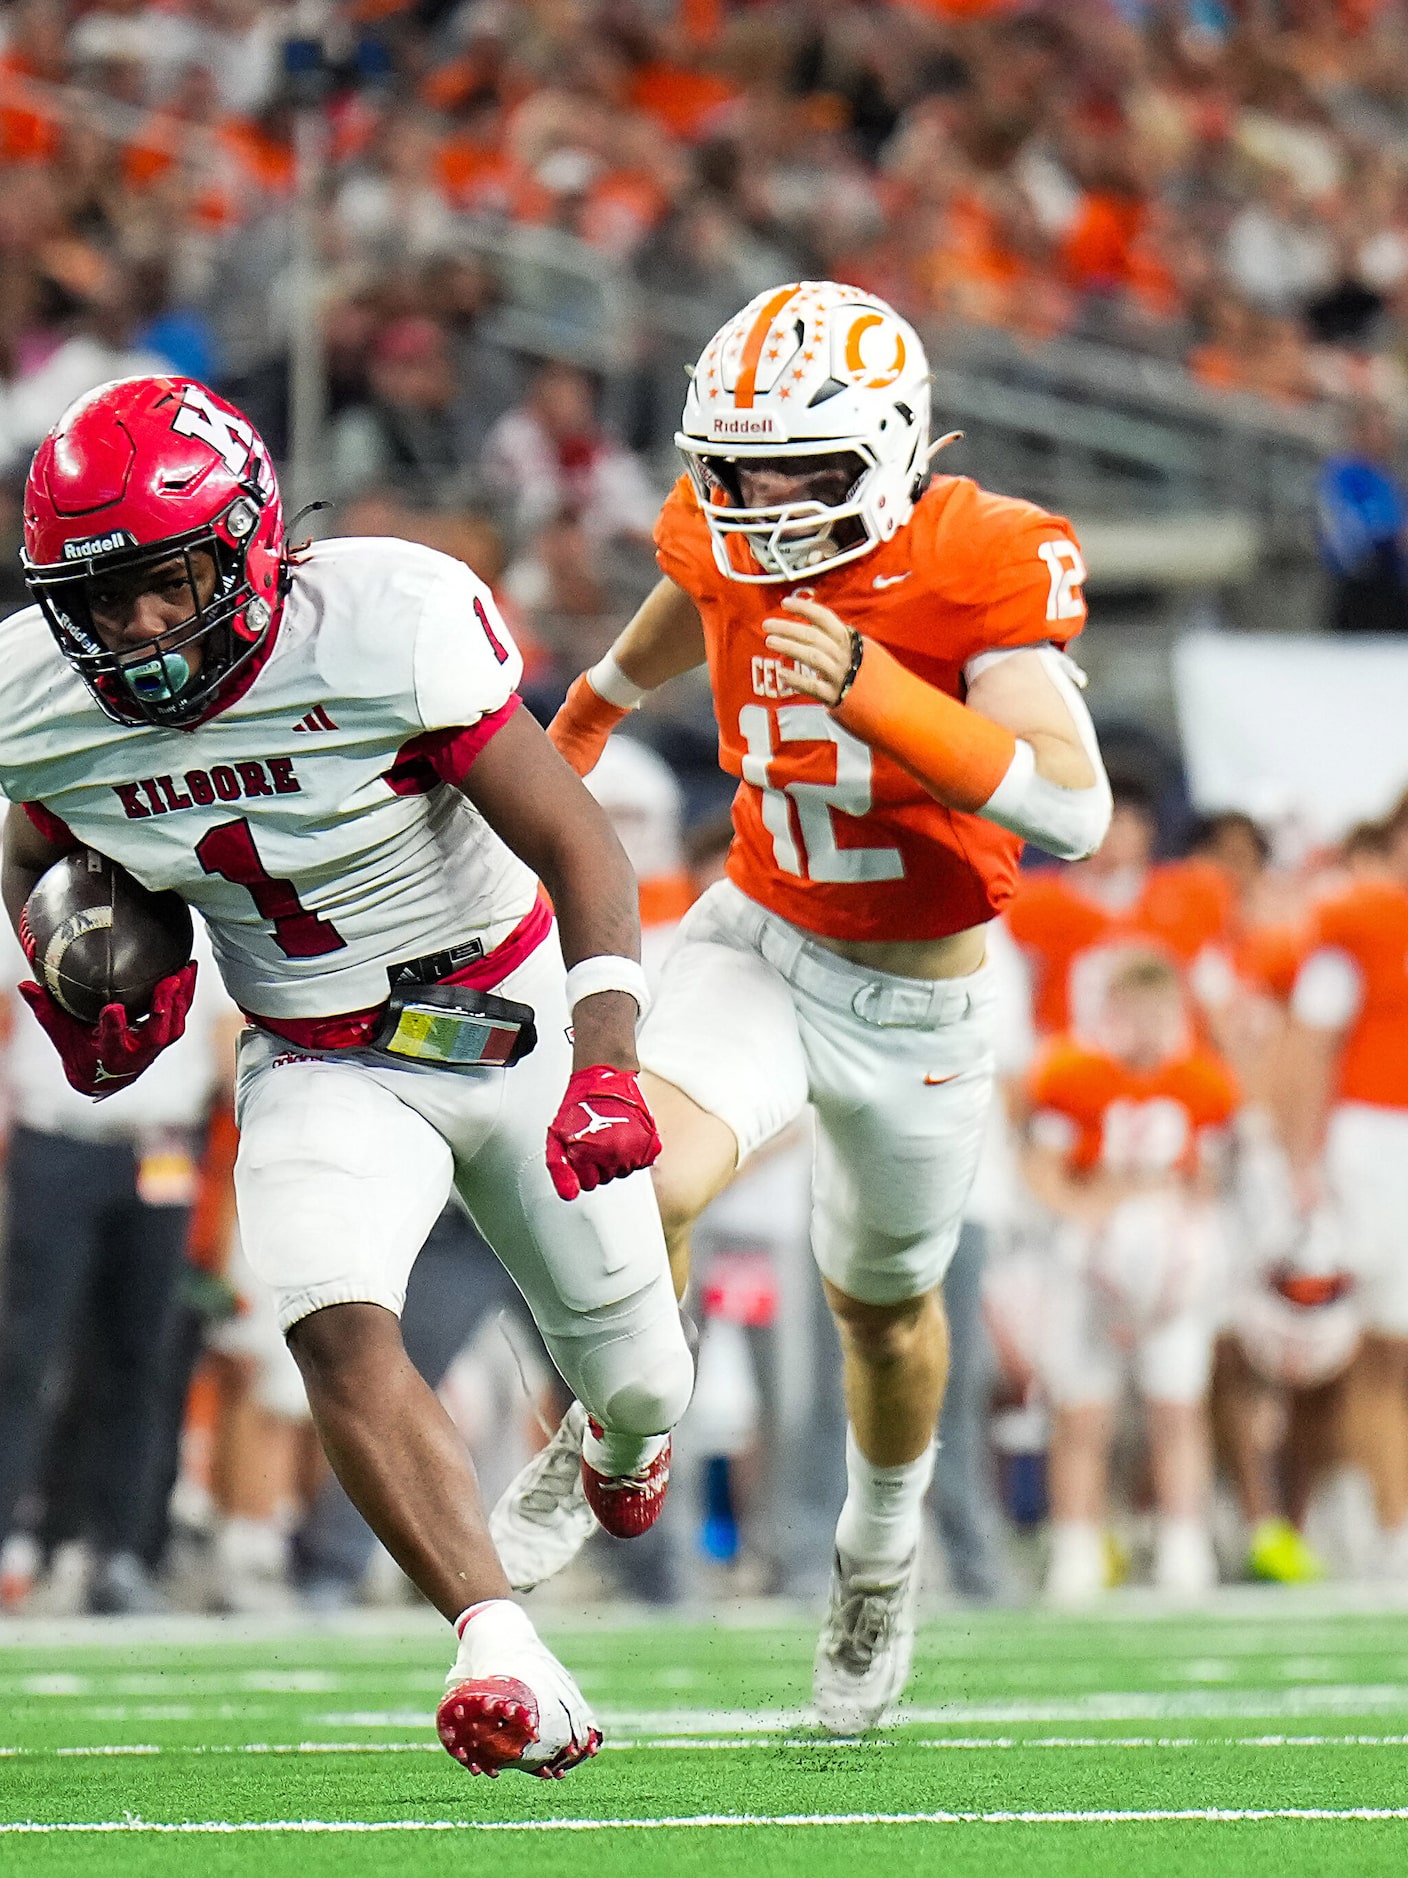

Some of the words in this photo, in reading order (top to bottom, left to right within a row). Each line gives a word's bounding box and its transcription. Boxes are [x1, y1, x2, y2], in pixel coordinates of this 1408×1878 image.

[171, 386, 254, 477] K
[714, 418, 773, 433] Riddell
[64, 531, 126, 559] Riddell
[1038, 540, 1087, 621] 12
[61, 612, 101, 656] Riddell
[472, 595, 510, 666] 1
[112, 757, 303, 819] KILGORE
[739, 703, 905, 884] 12
[194, 816, 349, 958] 1
